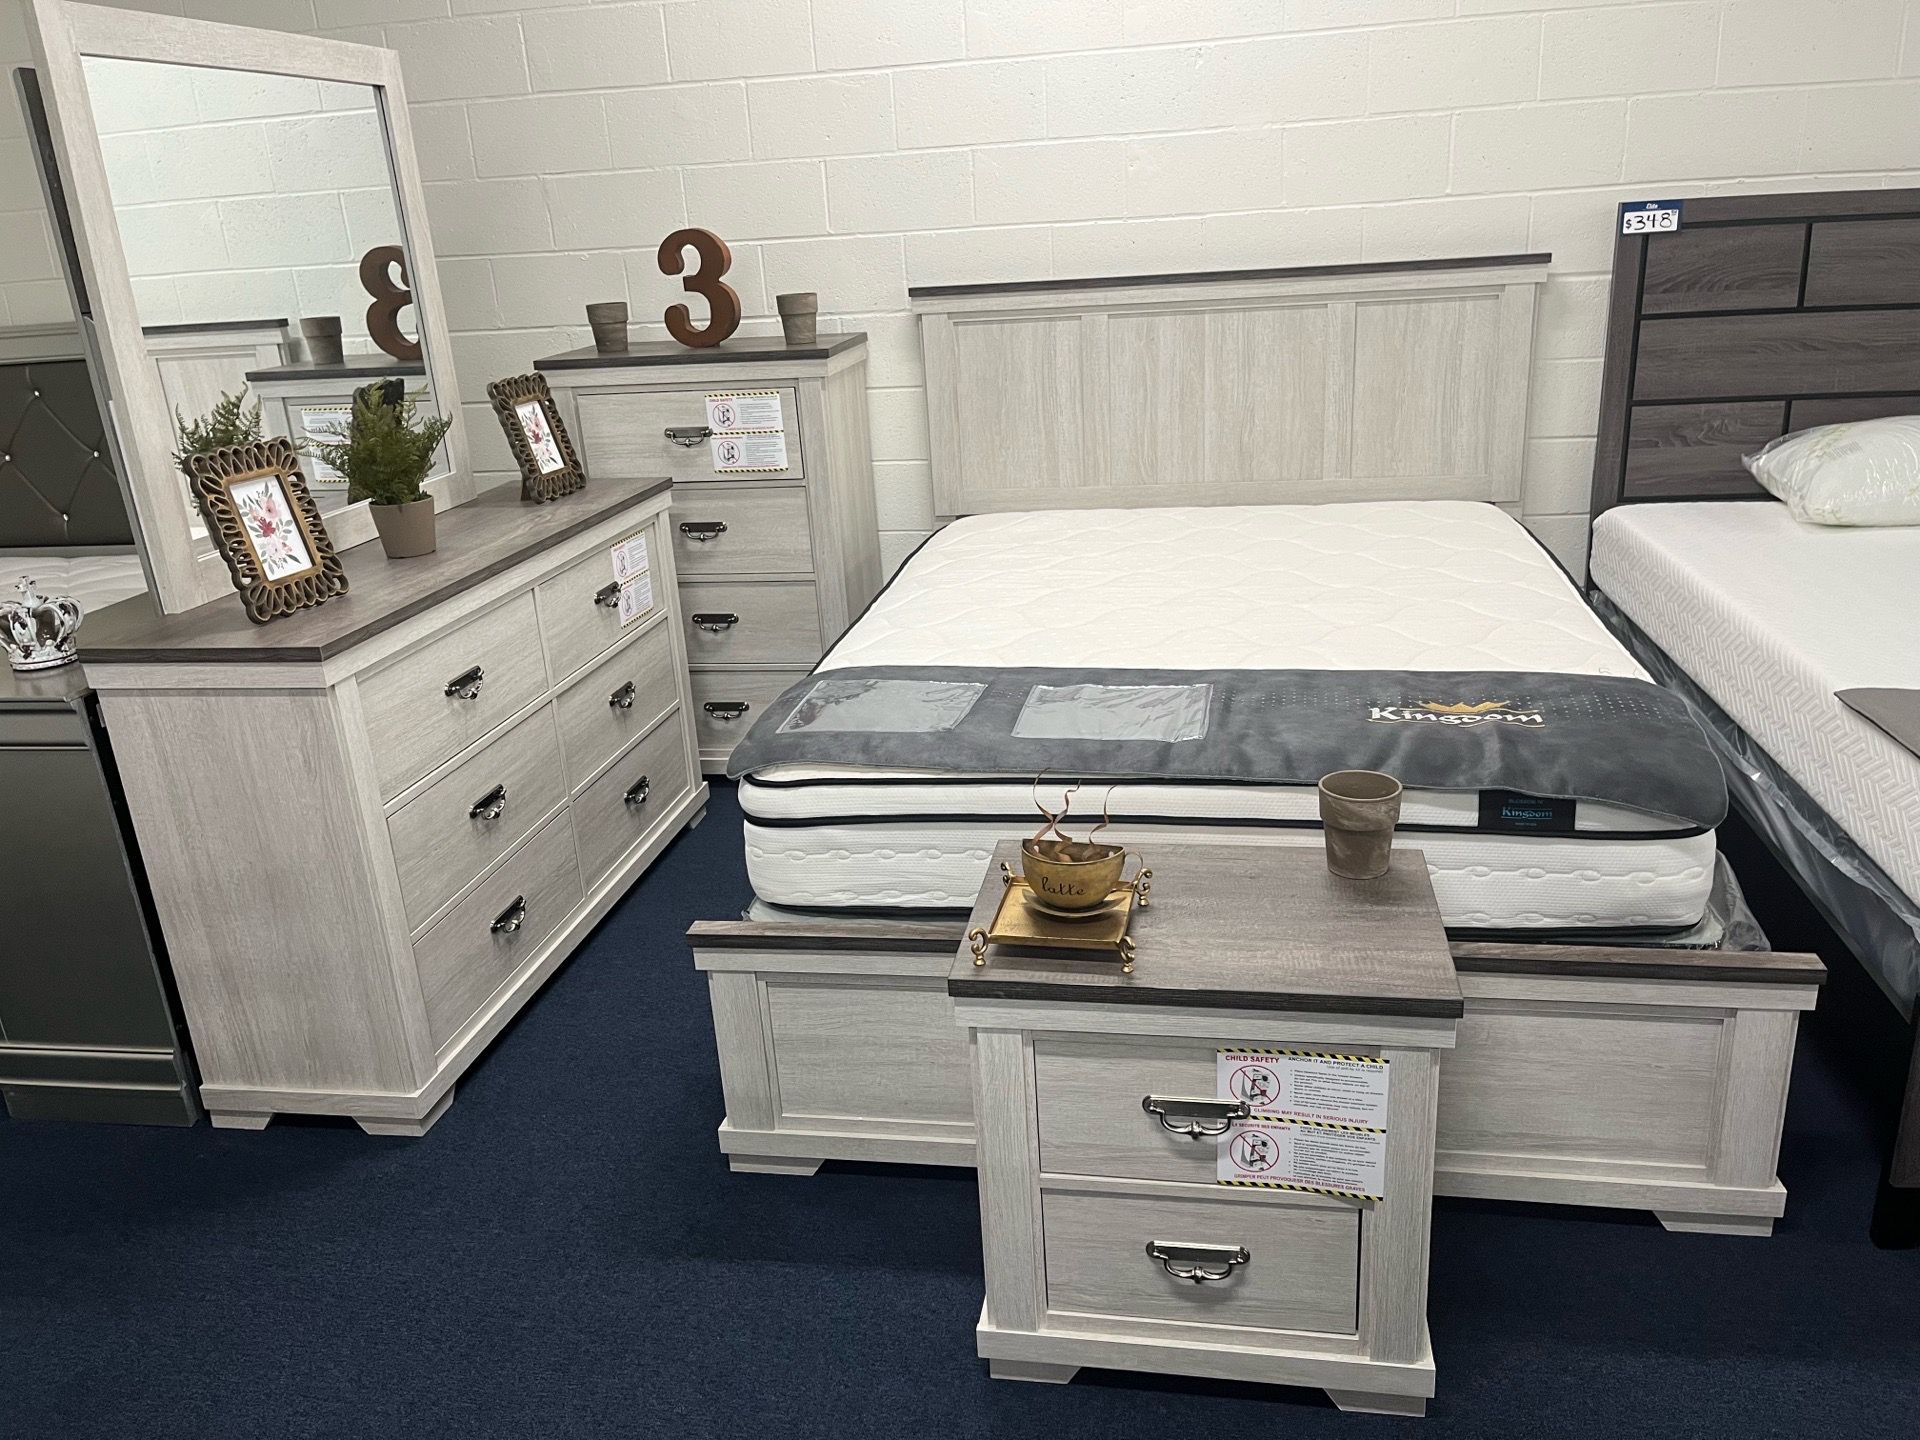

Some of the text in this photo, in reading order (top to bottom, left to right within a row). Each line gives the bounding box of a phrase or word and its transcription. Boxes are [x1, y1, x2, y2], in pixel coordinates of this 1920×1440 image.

[1625, 212, 1672, 231] $348
[657, 227, 741, 348] 3
[1369, 706, 1543, 725] Kingdom
[1502, 806, 1552, 819] Kingdom
[1041, 876, 1086, 896] latte
[1250, 1056, 1280, 1064] SAFETY
[1322, 1115, 1347, 1123] SERIOUS
